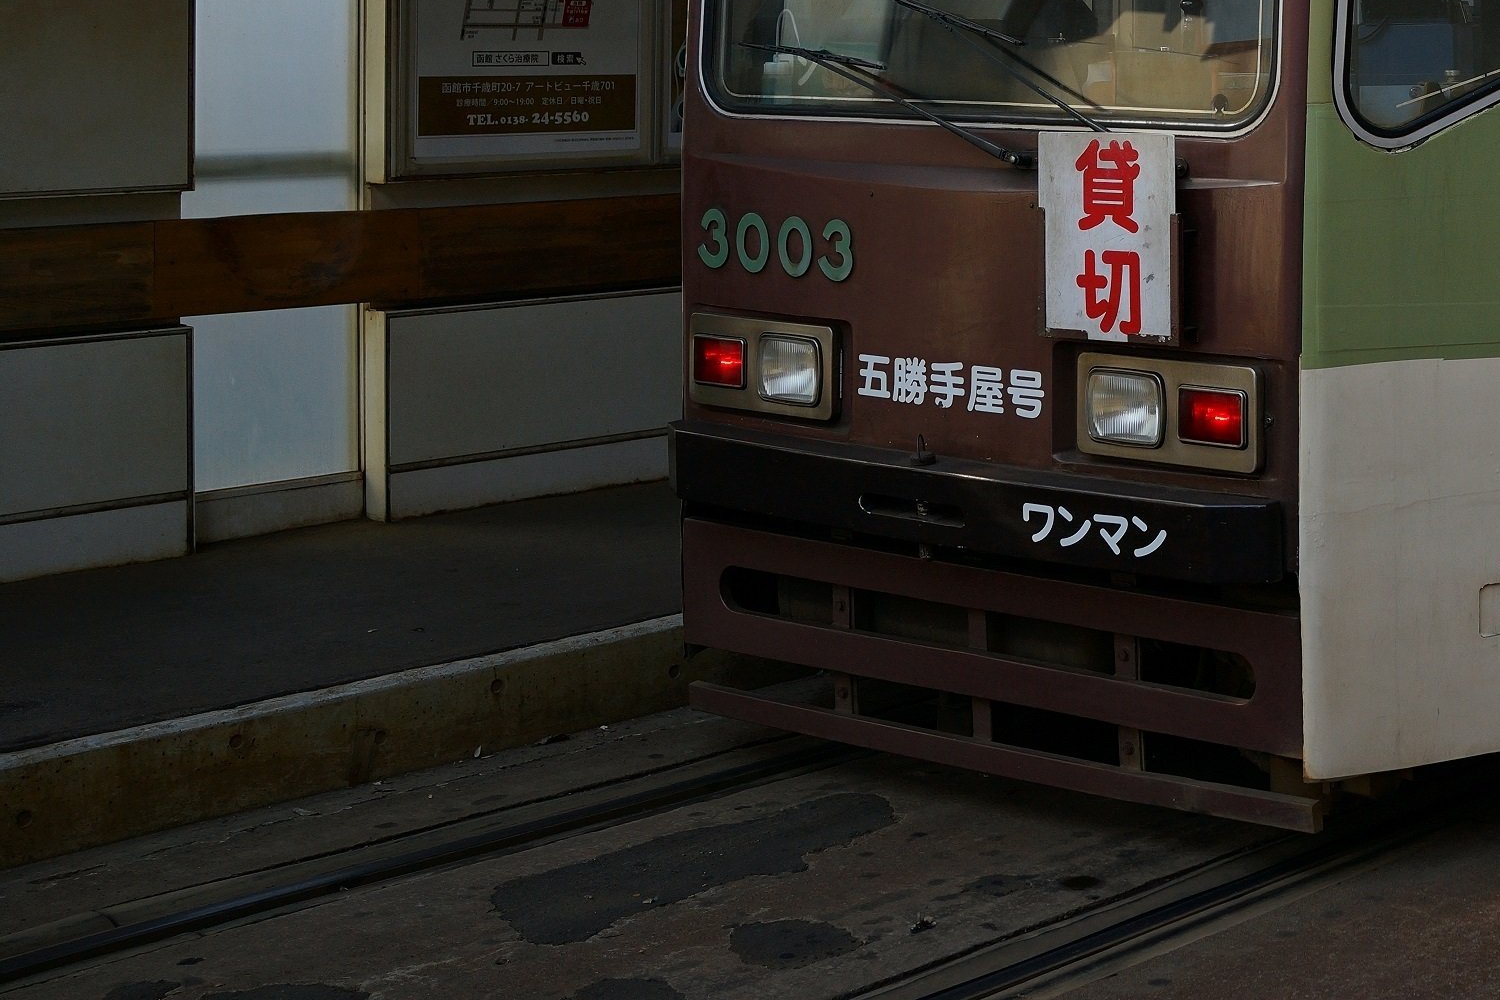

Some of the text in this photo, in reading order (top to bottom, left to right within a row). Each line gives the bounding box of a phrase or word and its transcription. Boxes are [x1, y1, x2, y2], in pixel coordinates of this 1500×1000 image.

[441, 81, 616, 95] 函館市千歳町20-7 アートビュー千歳701
[495, 53, 539, 64] さくら治療院
[696, 207, 854, 283] 3003
[1075, 139, 1143, 337] 貸切
[857, 353, 1046, 420] 五勝手屋号
[1022, 502, 1169, 559] ワンマン
